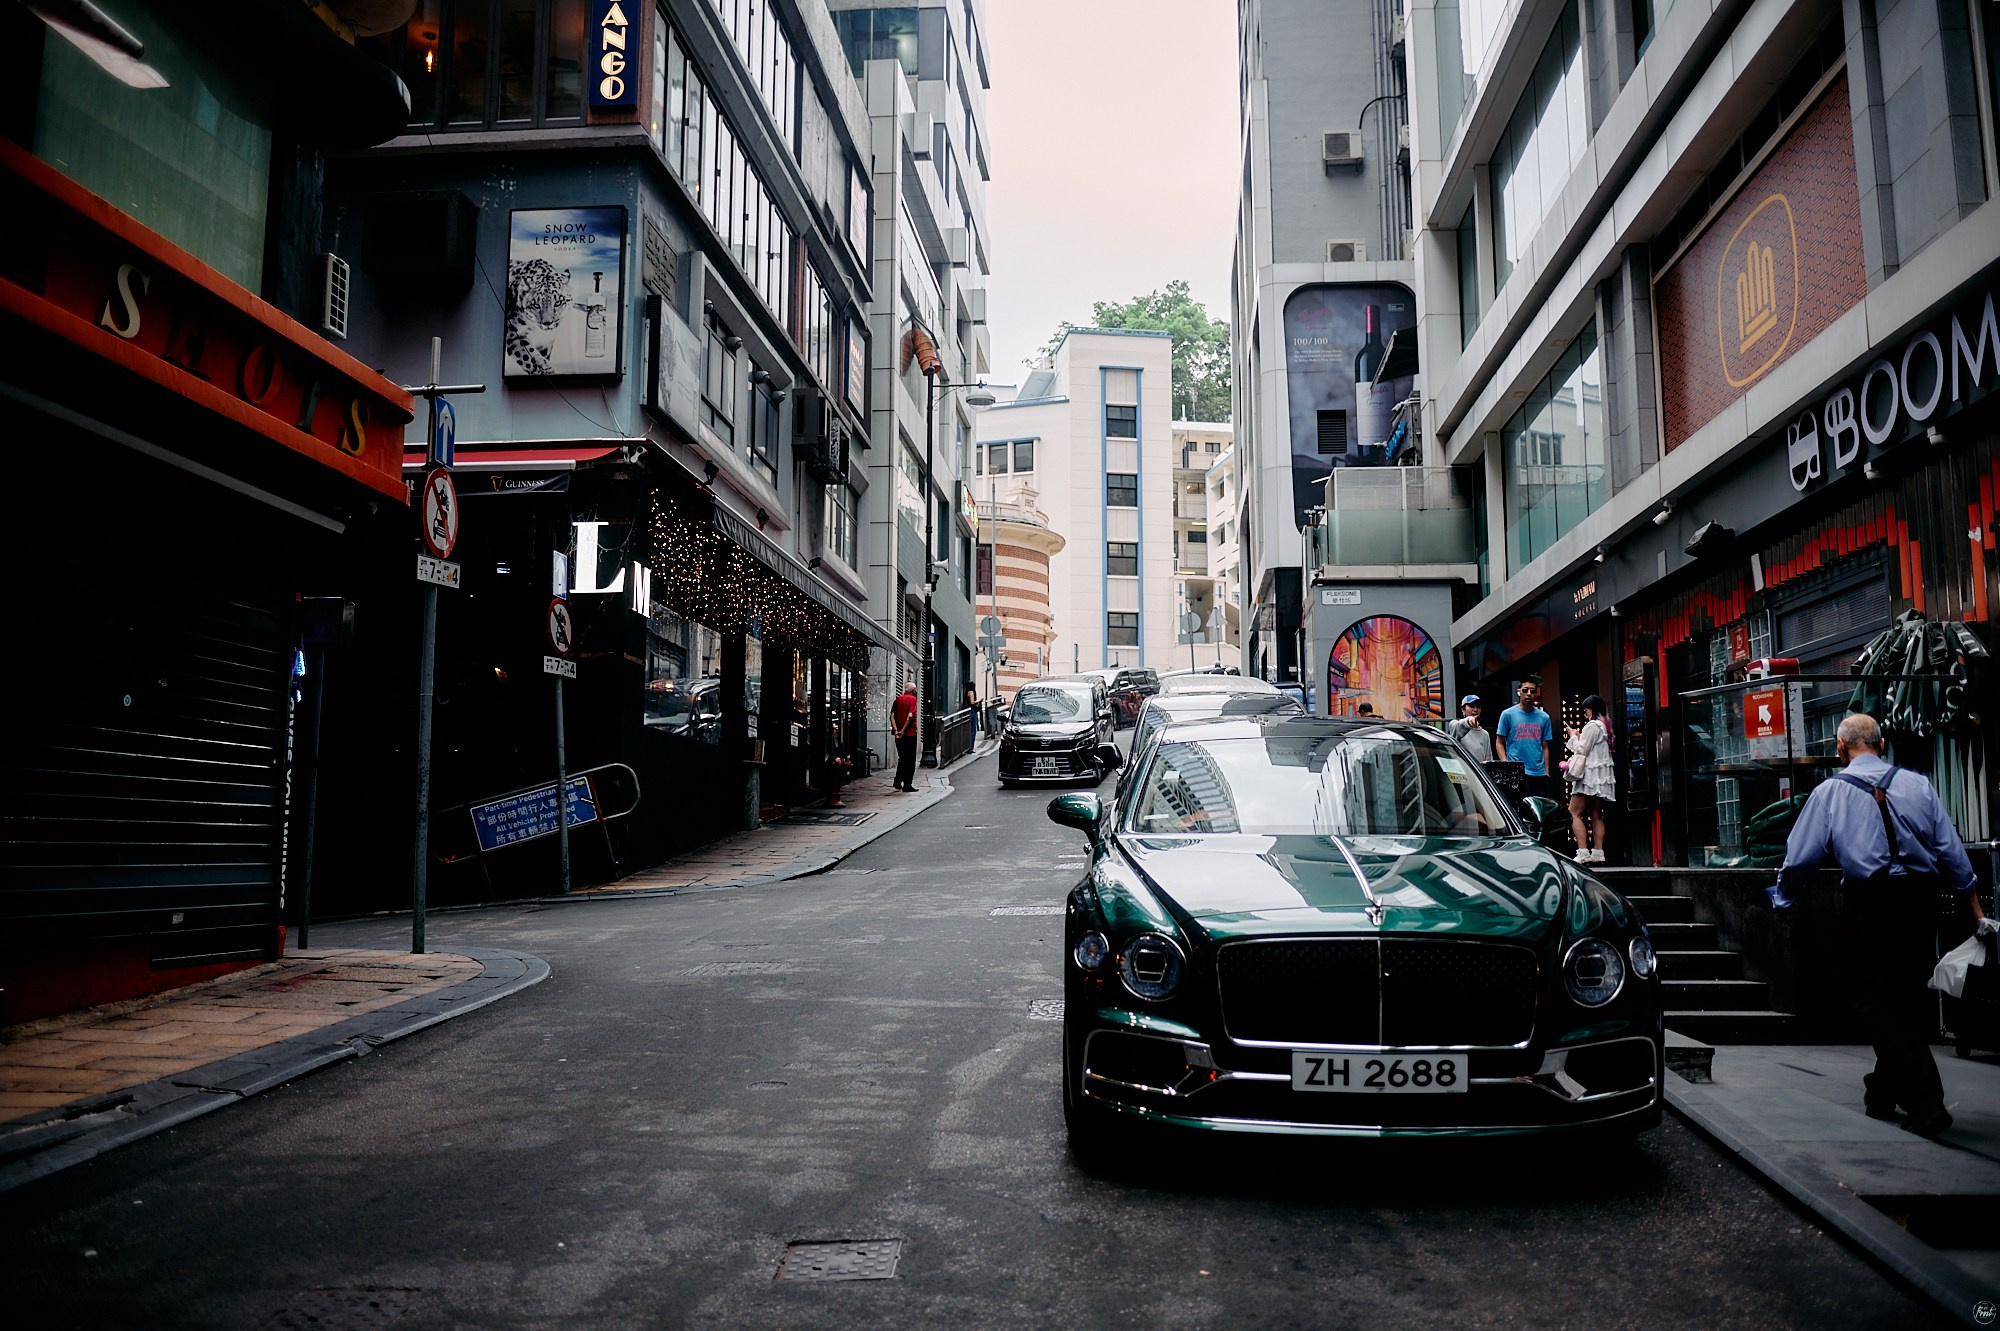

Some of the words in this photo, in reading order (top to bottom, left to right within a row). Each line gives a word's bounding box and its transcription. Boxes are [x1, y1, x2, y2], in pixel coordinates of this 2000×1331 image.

[600, 0, 628, 100] ANGO
[545, 223, 587, 234] SNOW
[535, 234, 596, 246] LEOPARD
[1293, 337, 1328, 346] 100/100
[505, 479, 545, 489] GUINNESS
[569, 521, 626, 594] L
[484, 799, 518, 813] Part-time
[518, 788, 557, 803] Pedestrian
[496, 822, 507, 833] All
[507, 816, 538, 830] Vehicles
[1304, 1058, 1350, 1086] ZH
[1363, 1059, 1457, 1087] 2688
